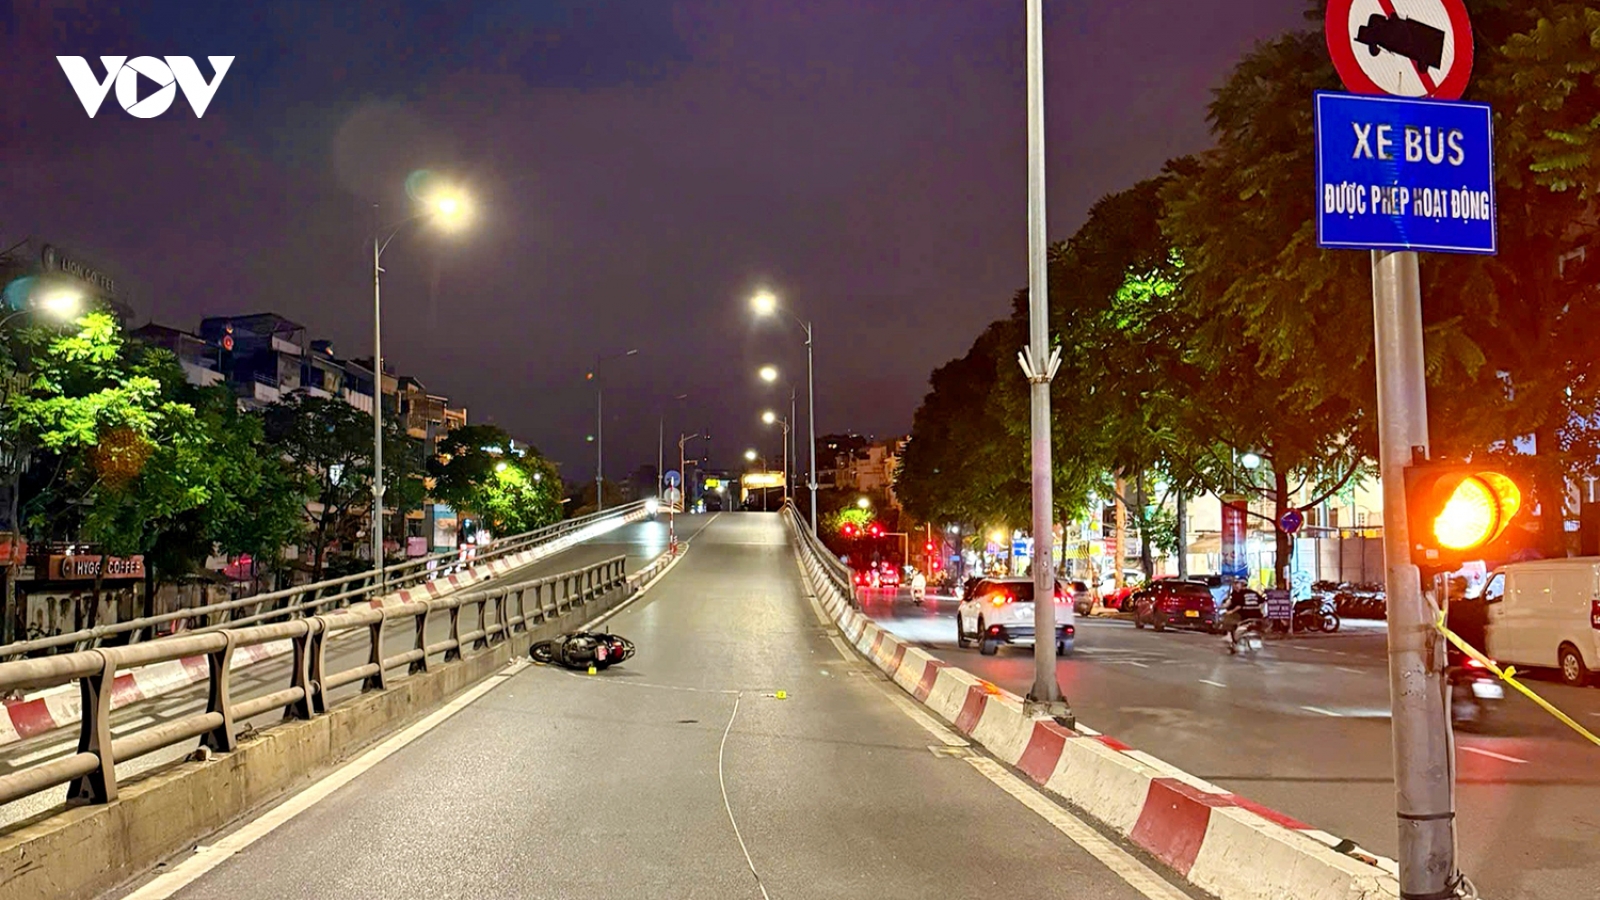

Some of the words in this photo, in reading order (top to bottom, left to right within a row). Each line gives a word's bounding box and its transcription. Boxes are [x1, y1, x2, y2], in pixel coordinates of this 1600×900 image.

[1351, 122, 1394, 160] XE
[1405, 125, 1465, 166] BUS
[1325, 181, 1366, 219] ĐƯỢC
[1371, 180, 1409, 215] PHÉP
[1413, 188, 1448, 223] HOẠT
[1451, 185, 1489, 224] ĐỘNG
